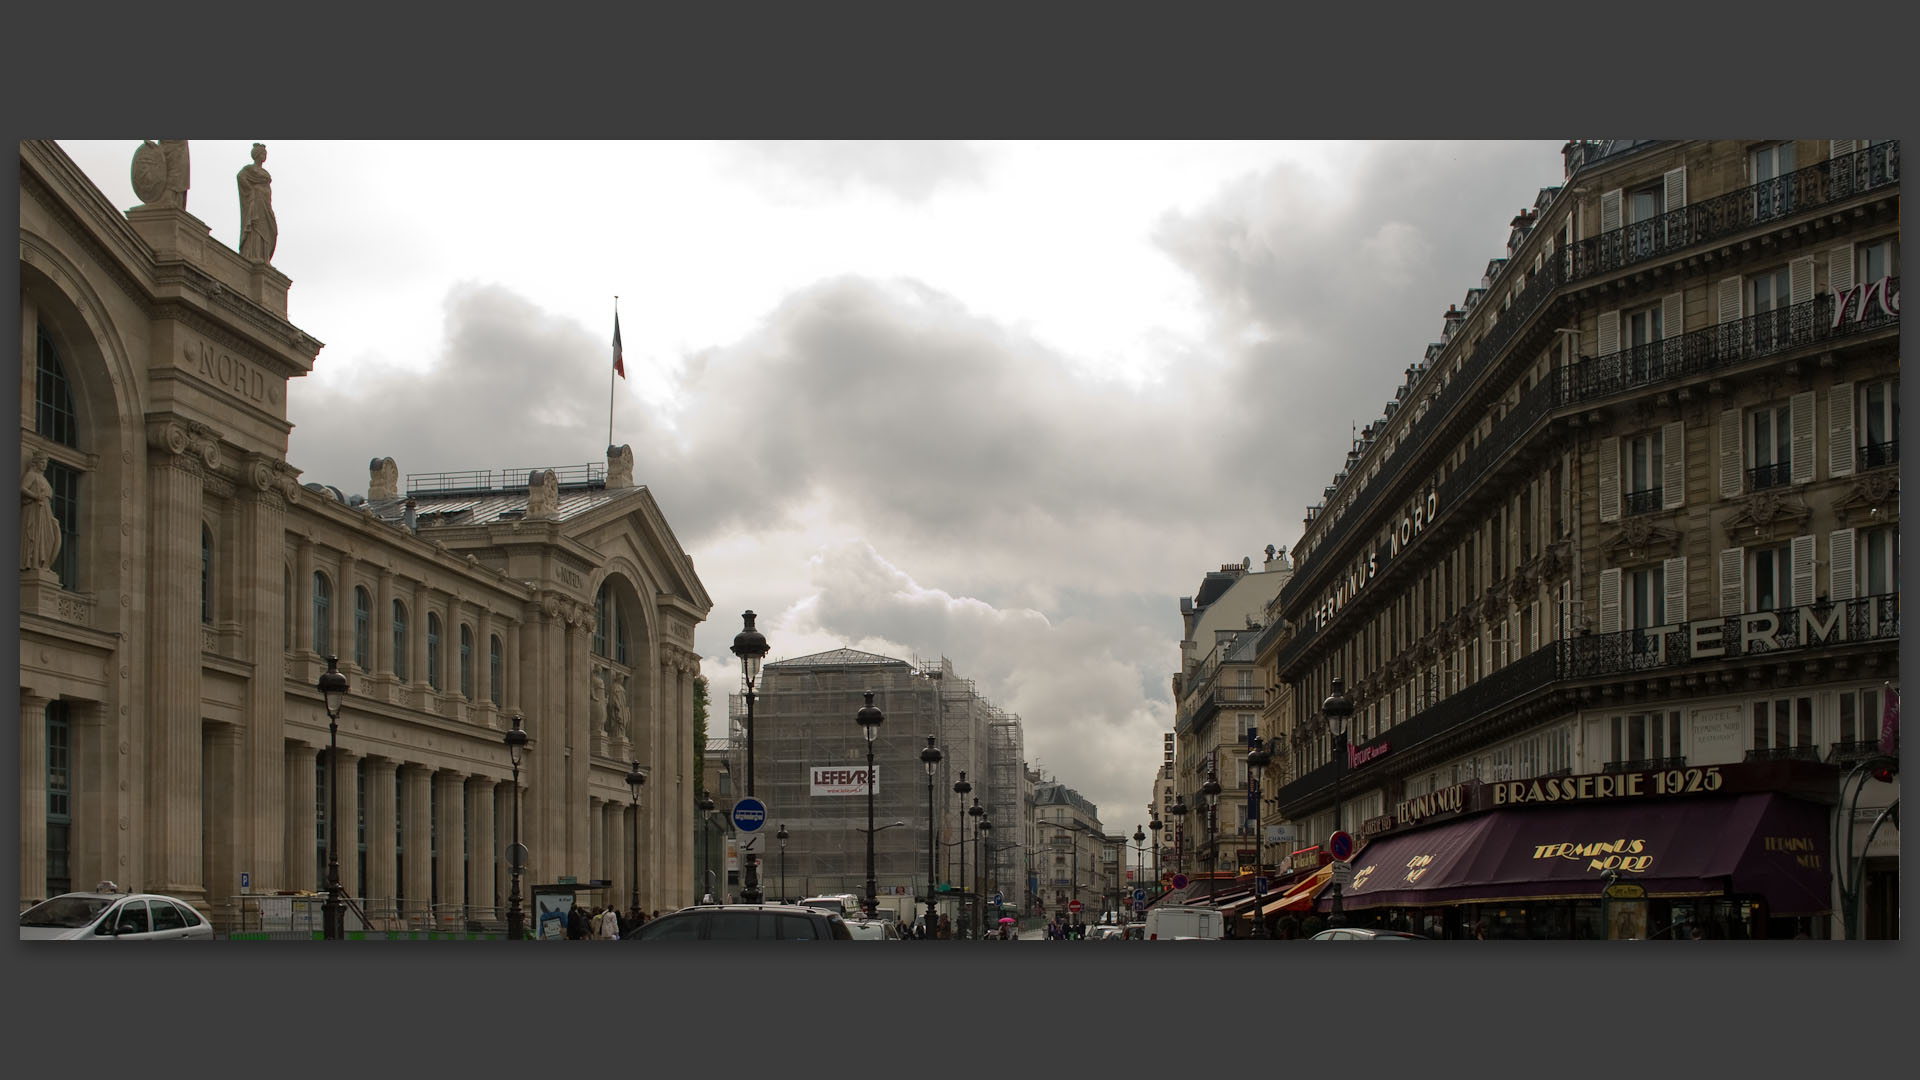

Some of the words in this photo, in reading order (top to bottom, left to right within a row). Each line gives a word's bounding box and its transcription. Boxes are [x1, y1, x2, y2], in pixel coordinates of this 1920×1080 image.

[199, 341, 263, 403] NORD
[1315, 553, 1378, 632] TERMINUS
[1390, 491, 1439, 560] NORD
[1643, 596, 1880, 662] TERMI
[1164, 733, 1173, 780] HOTEL
[1347, 743, 1370, 769] Mercure
[1396, 791, 1437, 826] TERMINUS
[1437, 784, 1464, 814] NORD
[1493, 772, 1645, 805] BRASSERIE
[1653, 767, 1723, 795] 1925
[1164, 786, 1173, 842] APOLLO
[1533, 839, 1647, 860] TERMINUS
[1586, 855, 1654, 873] NORD
